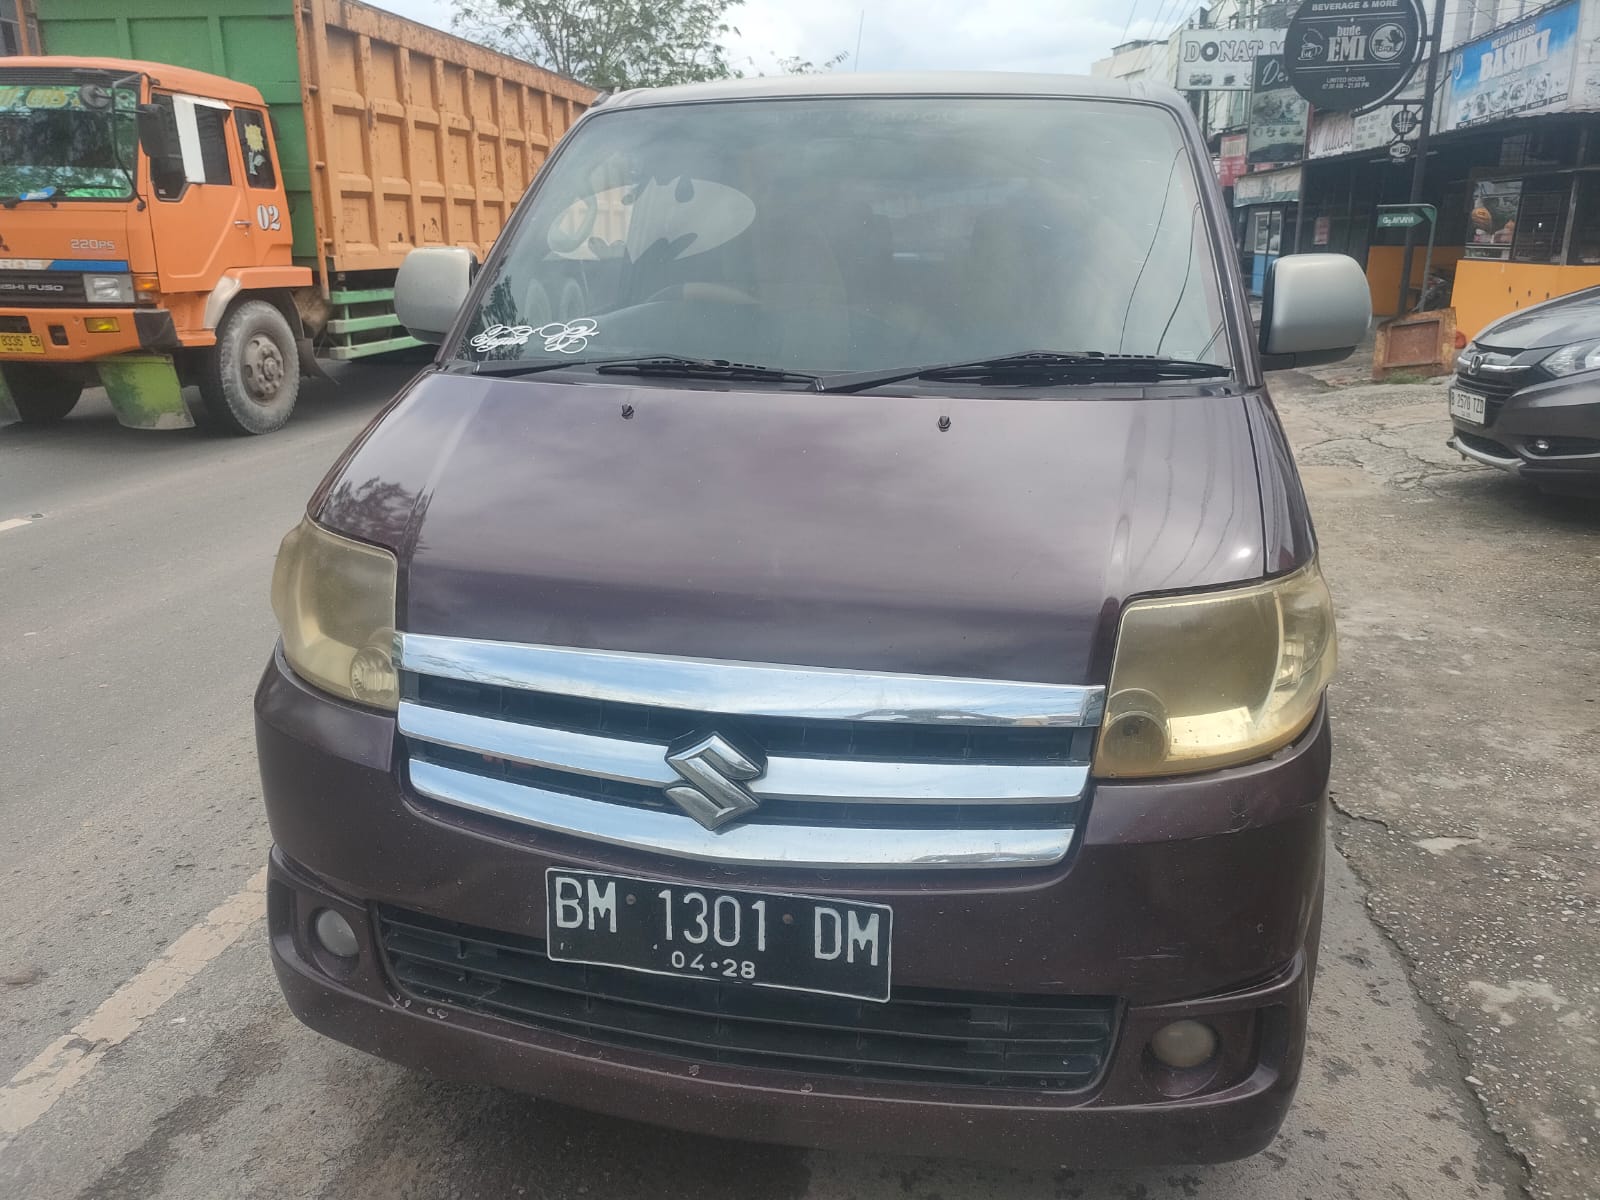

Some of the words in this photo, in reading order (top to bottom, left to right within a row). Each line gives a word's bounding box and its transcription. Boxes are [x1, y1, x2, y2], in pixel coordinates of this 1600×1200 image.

[1312, 1, 1360, 11] BEVERAGE
[1362, 1, 1369, 9] &
[1184, 40, 1264, 62] DONAT
[1326, 35, 1368, 62] EMI
[1479, 28, 1552, 82] BASUKI
[257, 204, 281, 231] 02
[70, 239, 115, 250] 220PS
[27, 284, 64, 292] FUSO
[555, 876, 617, 933] BM
[658, 889, 766, 952] 1301
[814, 906, 879, 967] DM
